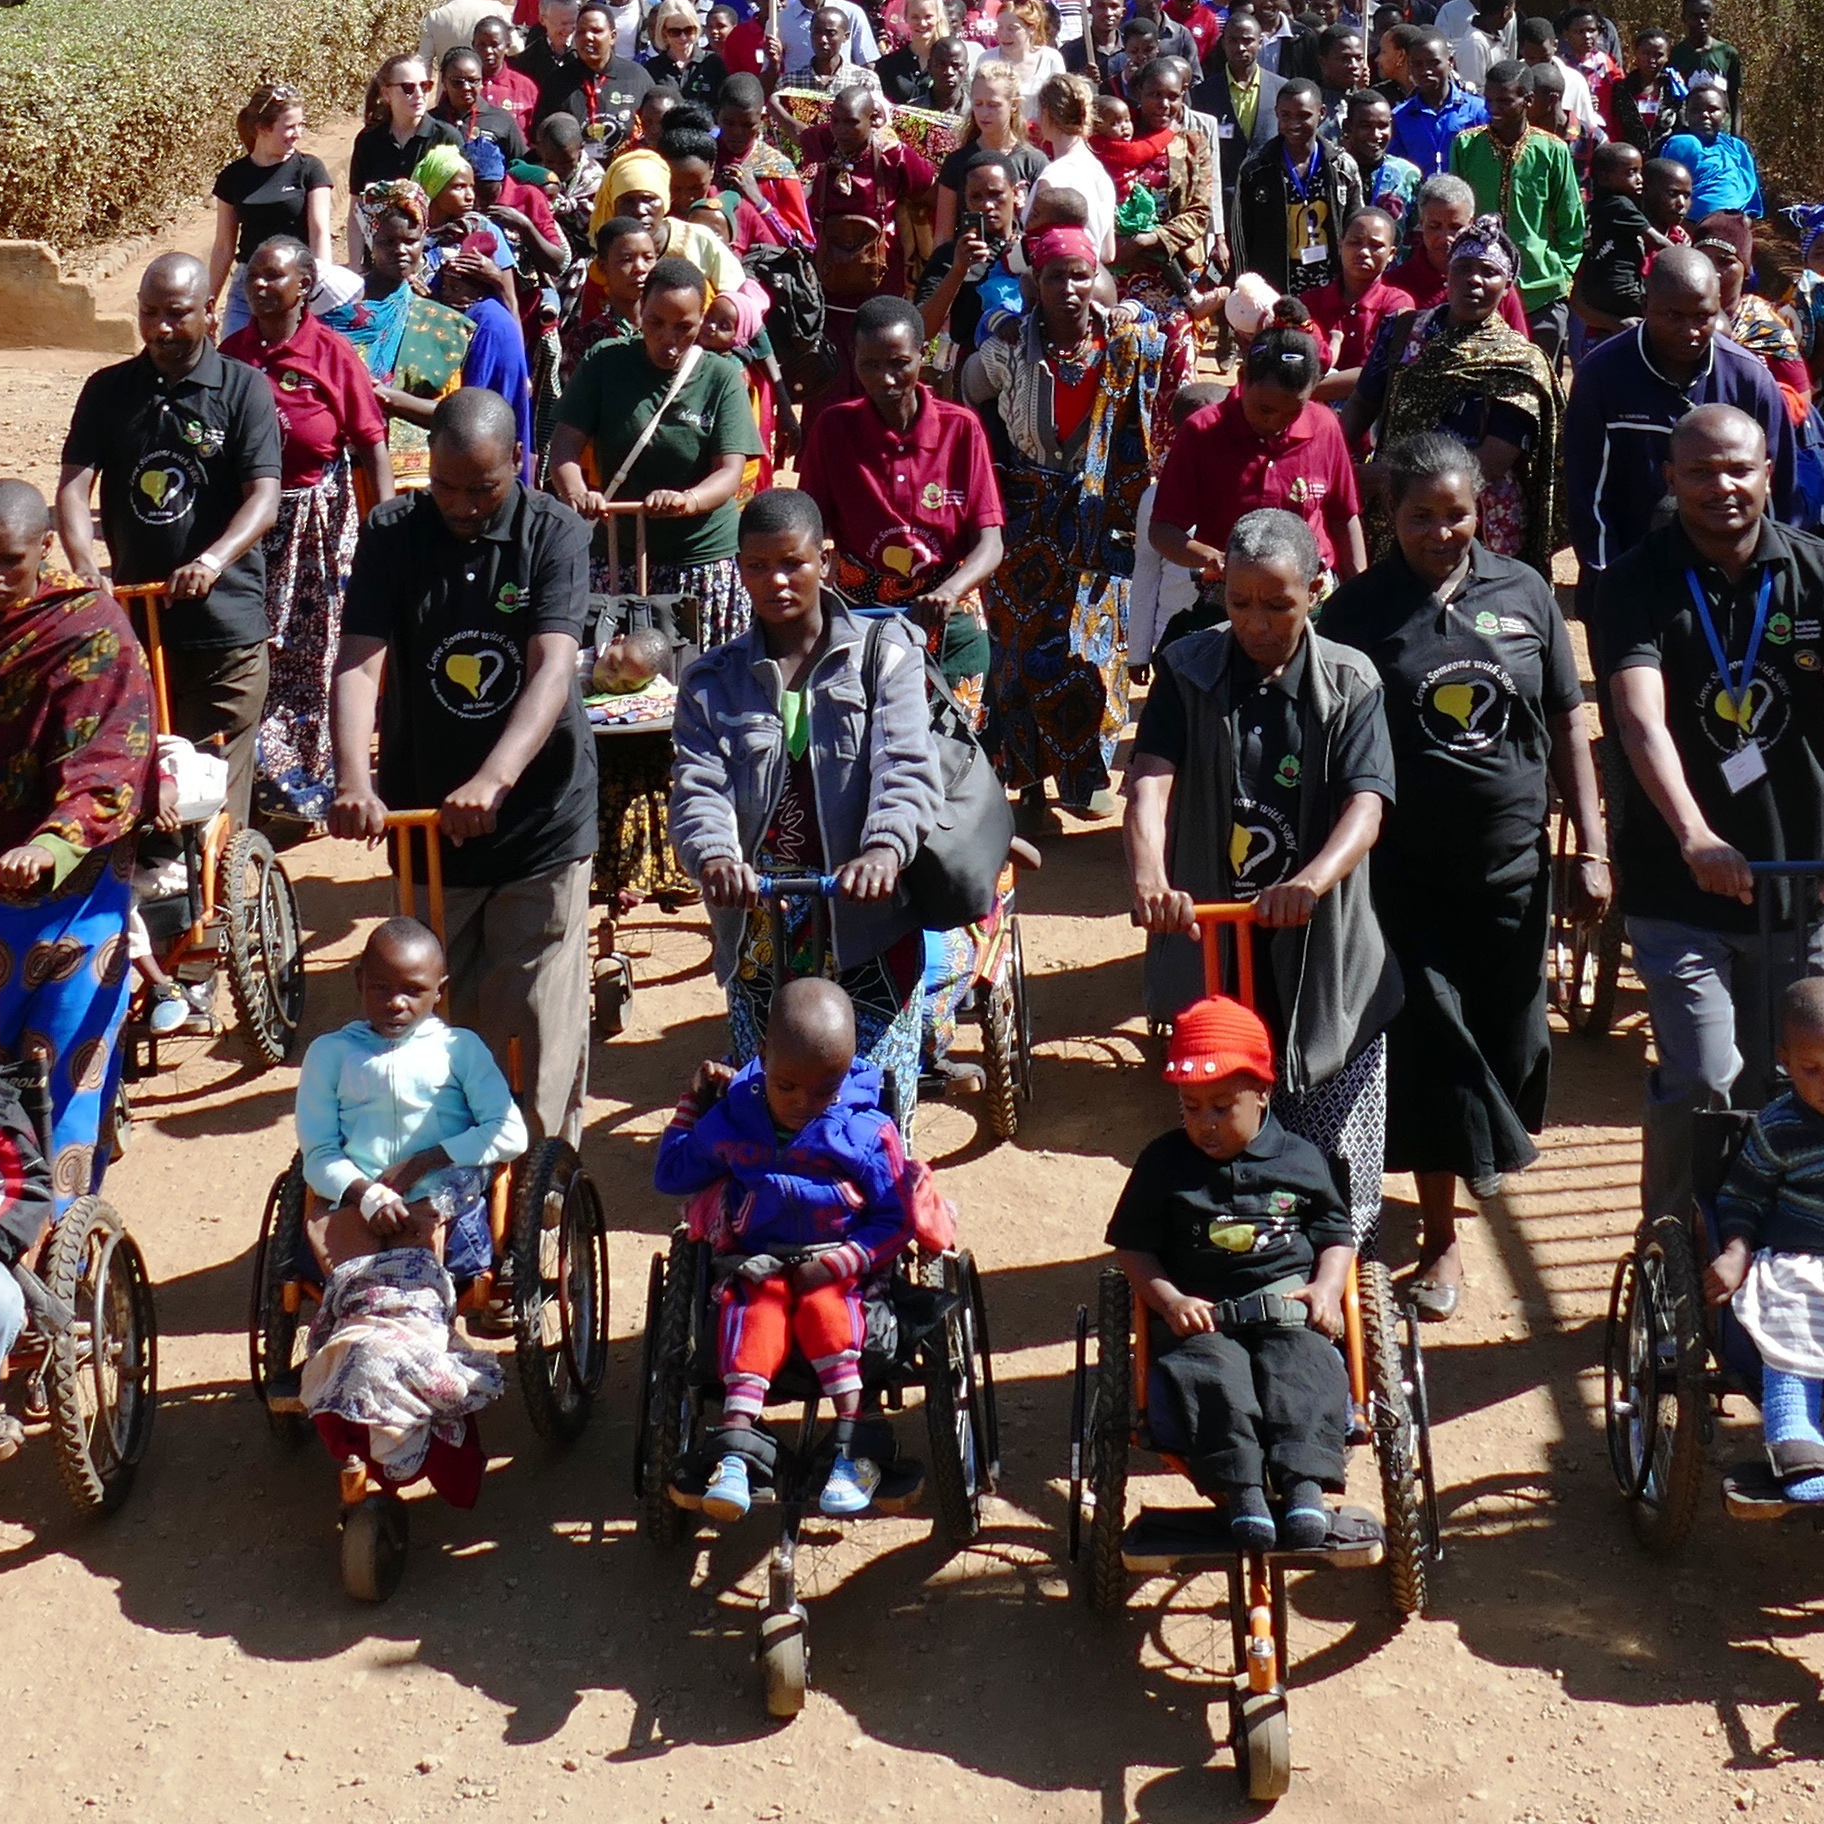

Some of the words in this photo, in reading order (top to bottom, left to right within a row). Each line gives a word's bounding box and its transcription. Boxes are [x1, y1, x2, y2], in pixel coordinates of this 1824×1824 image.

[1412, 681, 1429, 707] Love
[1426, 659, 1471, 684] Someone
[1473, 660, 1502, 675] with
[1259, 802, 1286, 826] with
